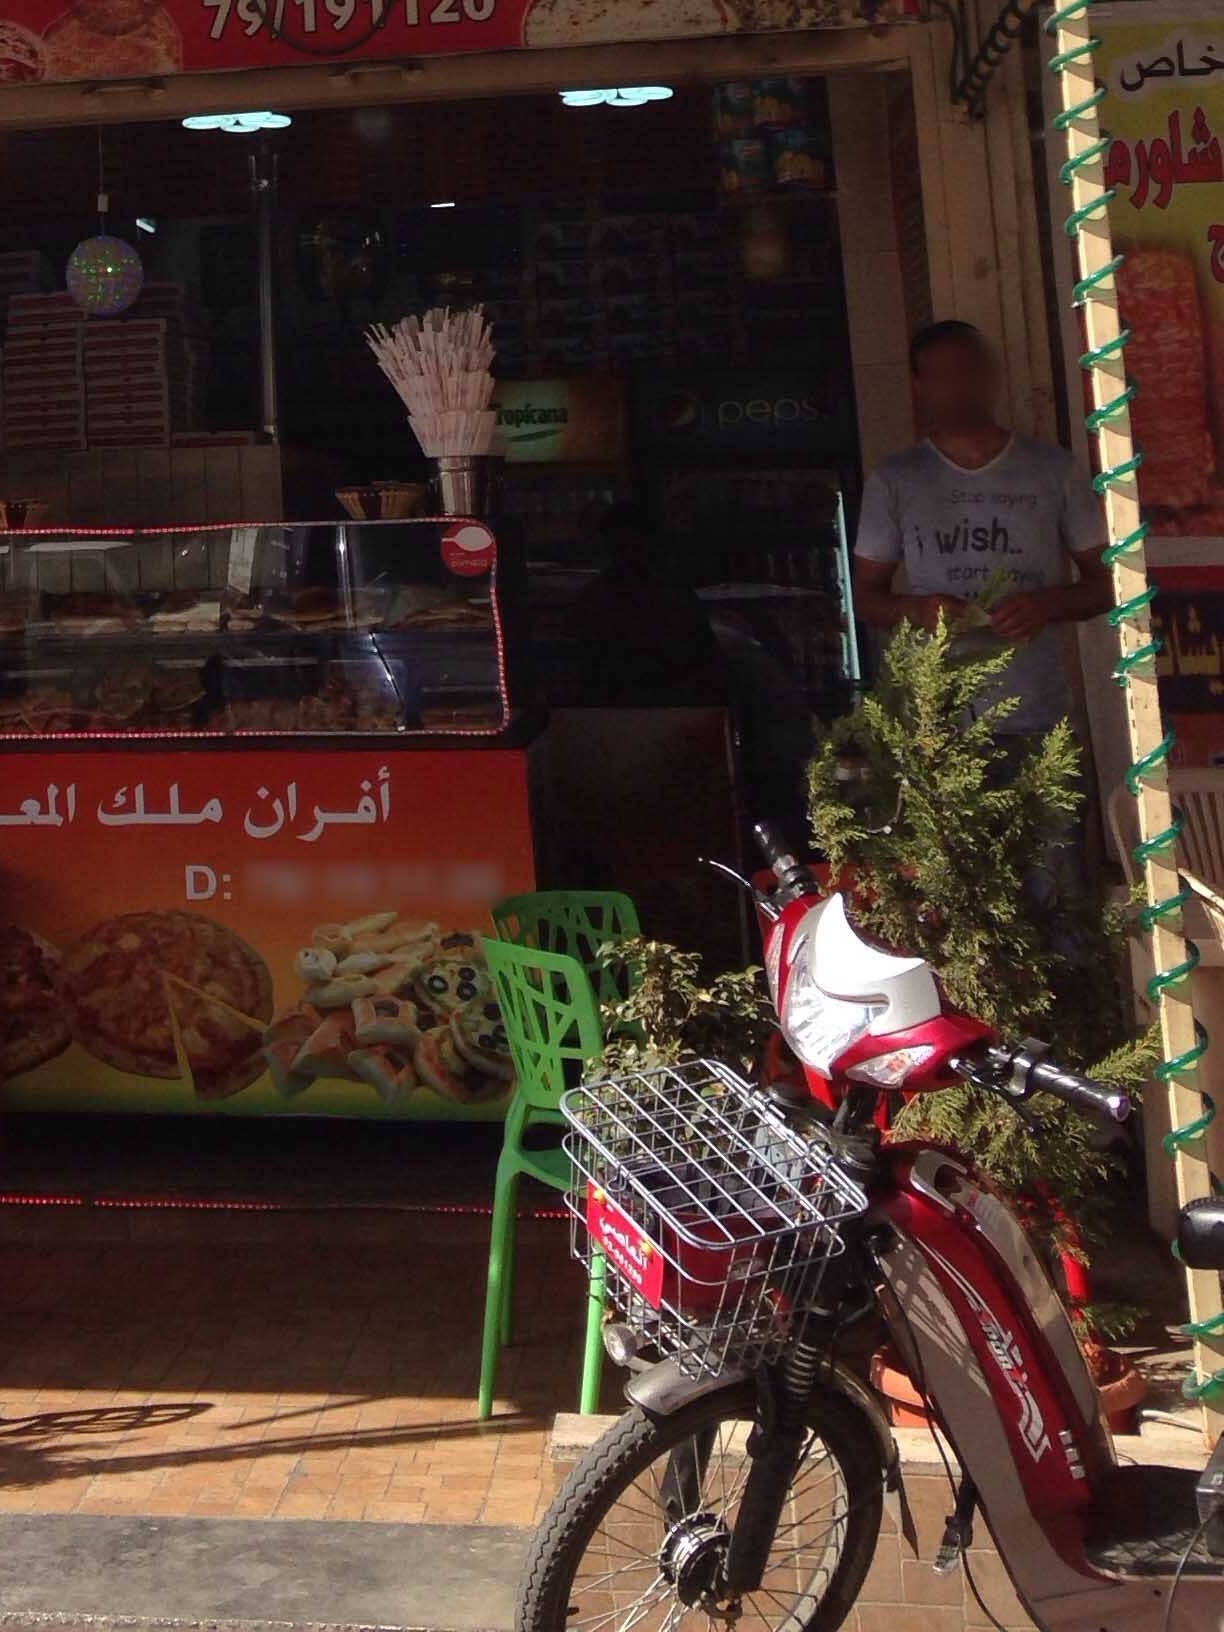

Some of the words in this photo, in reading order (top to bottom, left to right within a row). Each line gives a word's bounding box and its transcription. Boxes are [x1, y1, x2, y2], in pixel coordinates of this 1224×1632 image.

[97, 783, 223, 825] ملك
[244, 767, 392, 841] أفران
[185, 864, 233, 901] D:
